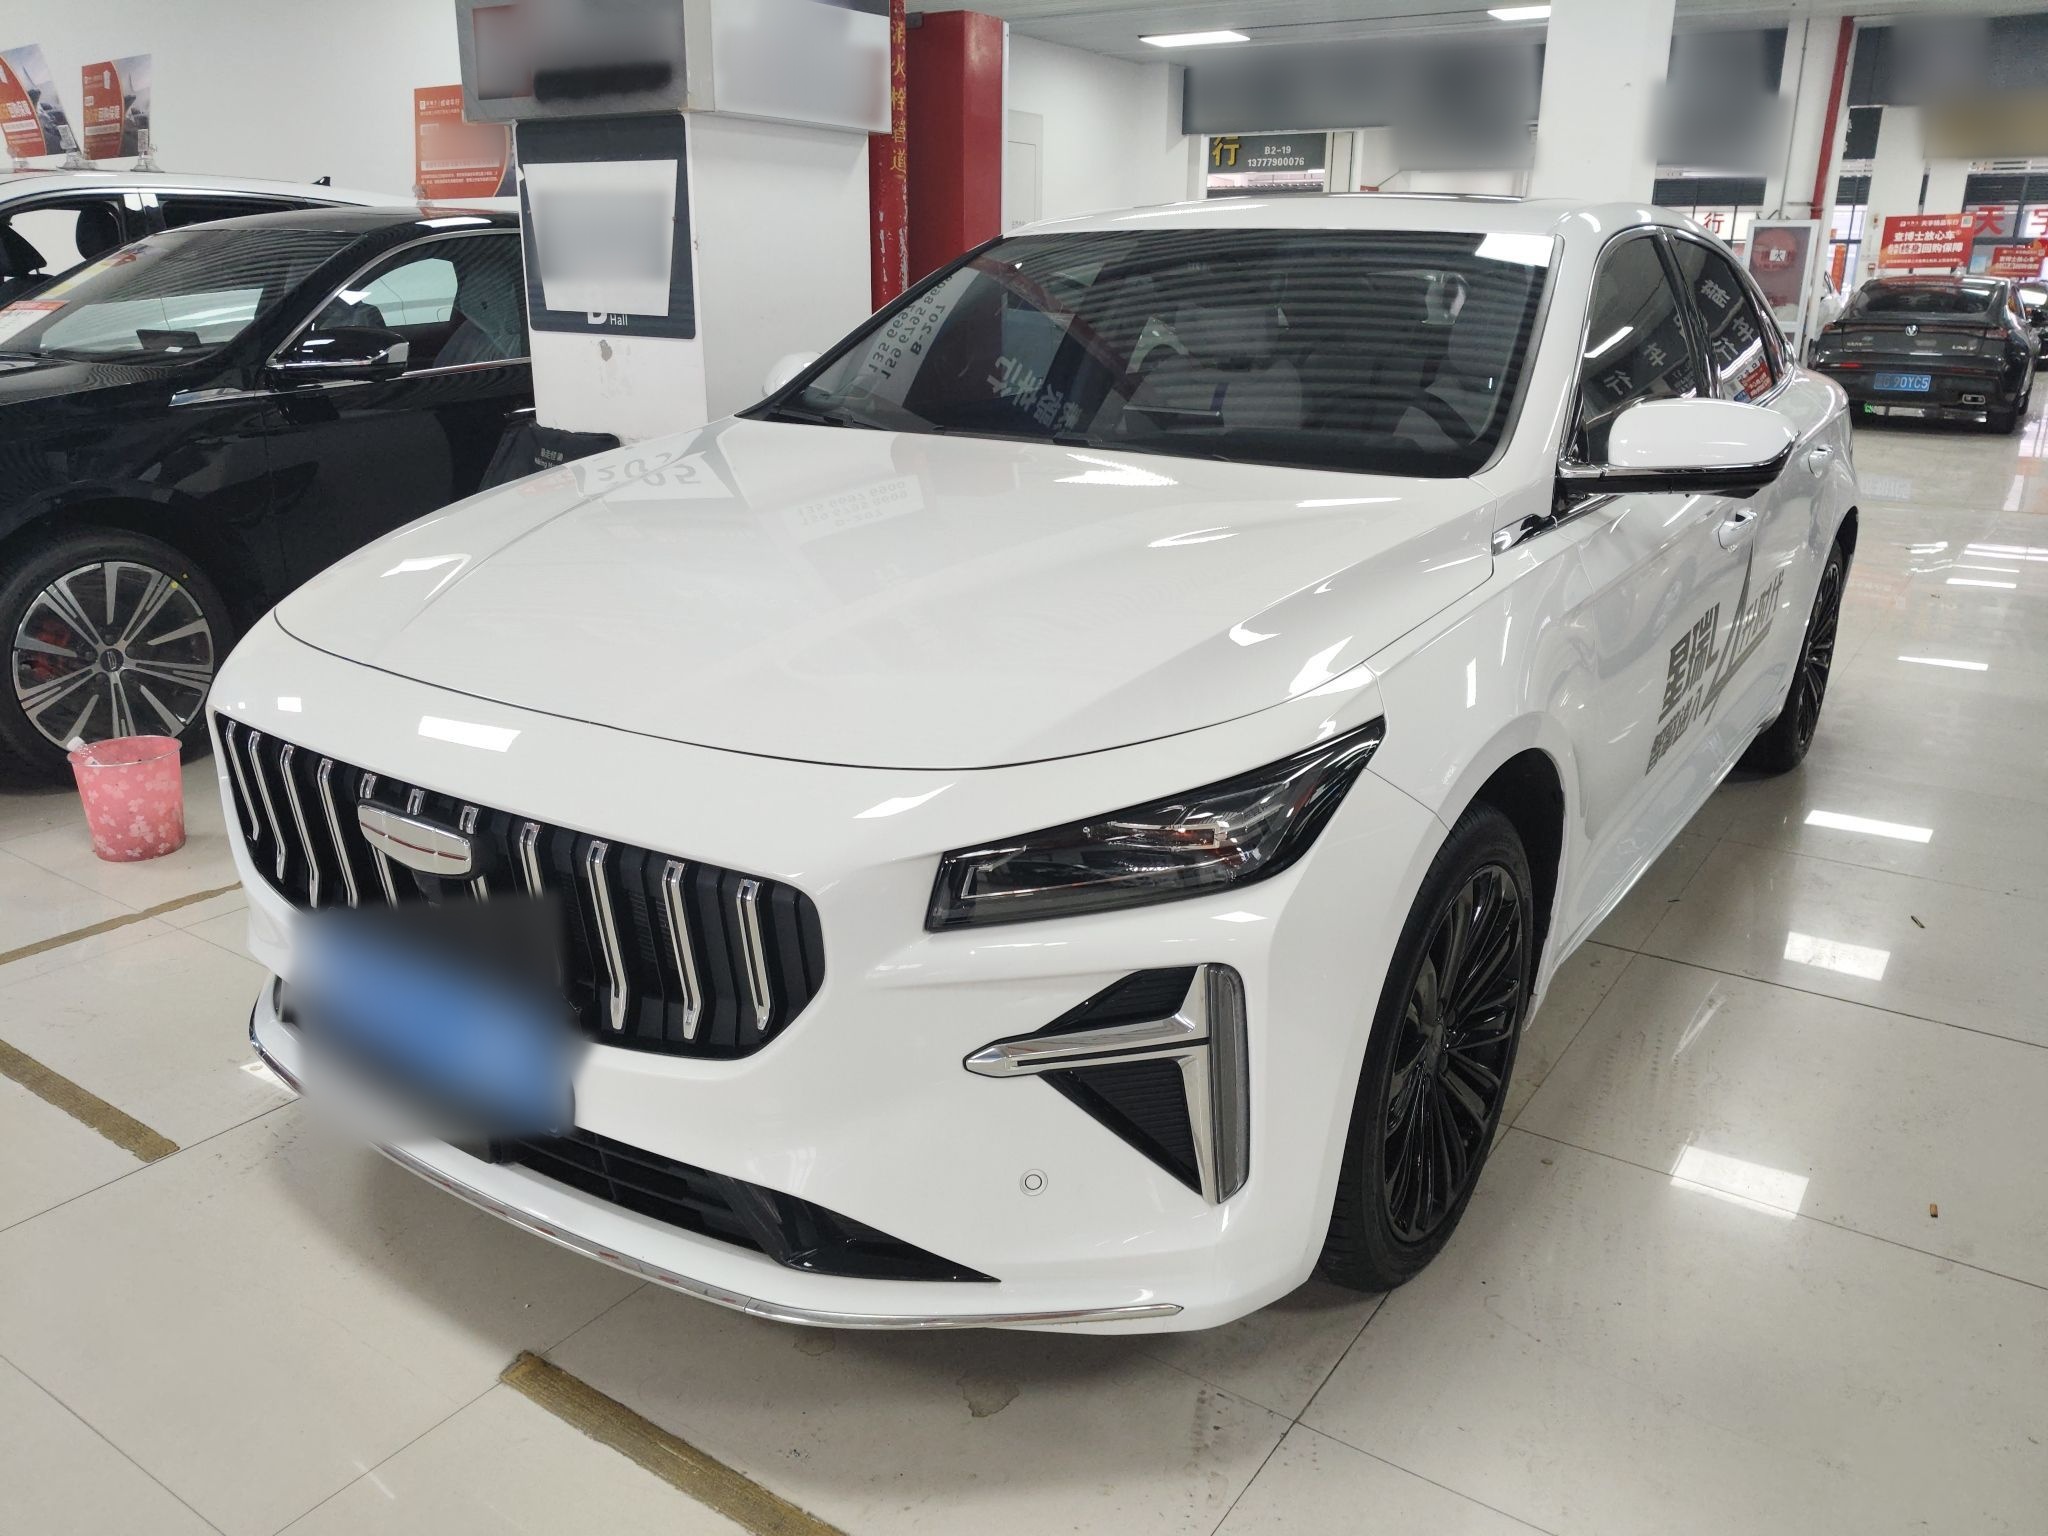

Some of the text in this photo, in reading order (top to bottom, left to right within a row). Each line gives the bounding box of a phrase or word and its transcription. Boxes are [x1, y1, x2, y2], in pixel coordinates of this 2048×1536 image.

[1212, 136, 1240, 166] 行
[1264, 146, 1291, 154] B2-19
[1247, 157, 1304, 167] 13777900076
[1704, 212, 1725, 234] 行
[610, 314, 628, 325] Hall
